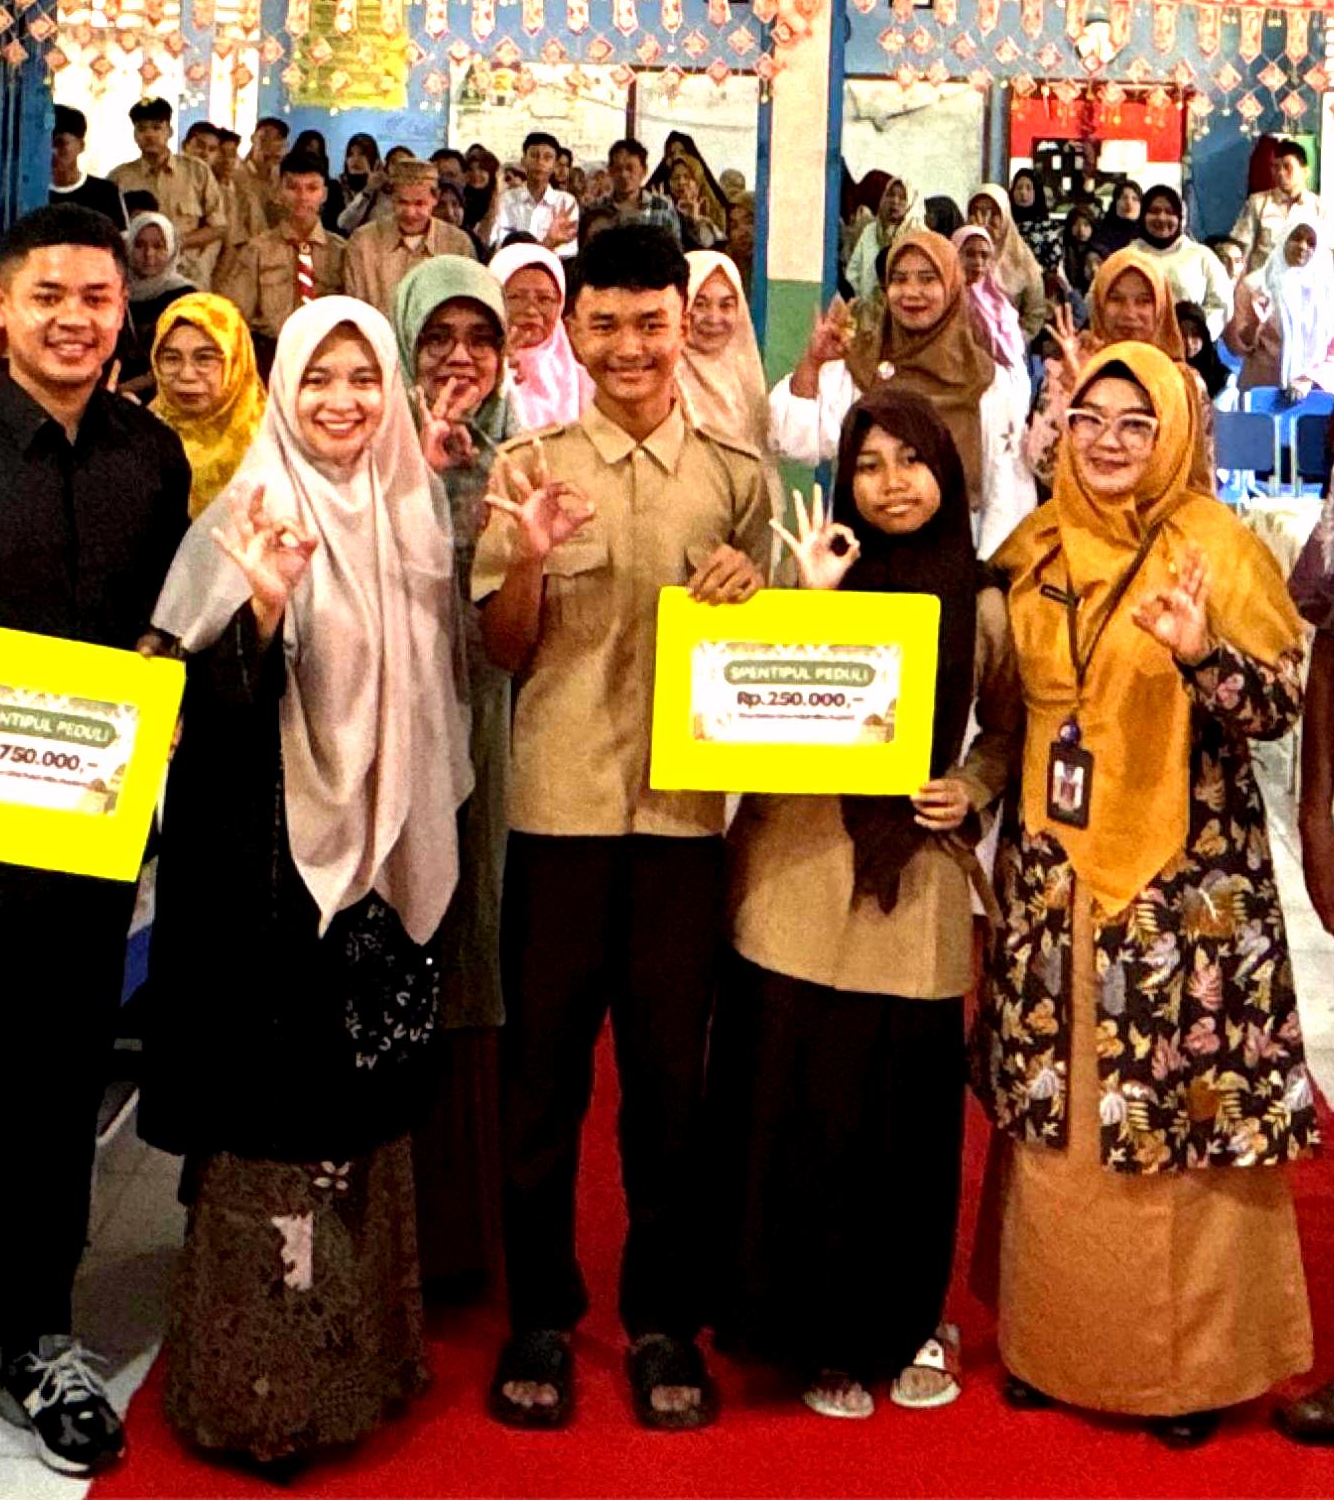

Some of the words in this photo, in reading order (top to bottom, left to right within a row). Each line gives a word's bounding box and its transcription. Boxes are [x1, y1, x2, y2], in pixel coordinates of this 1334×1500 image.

[730, 666, 813, 680] SPENTIPUL
[816, 667, 868, 680] PEDULI
[56, 720, 110, 742] PEDULI
